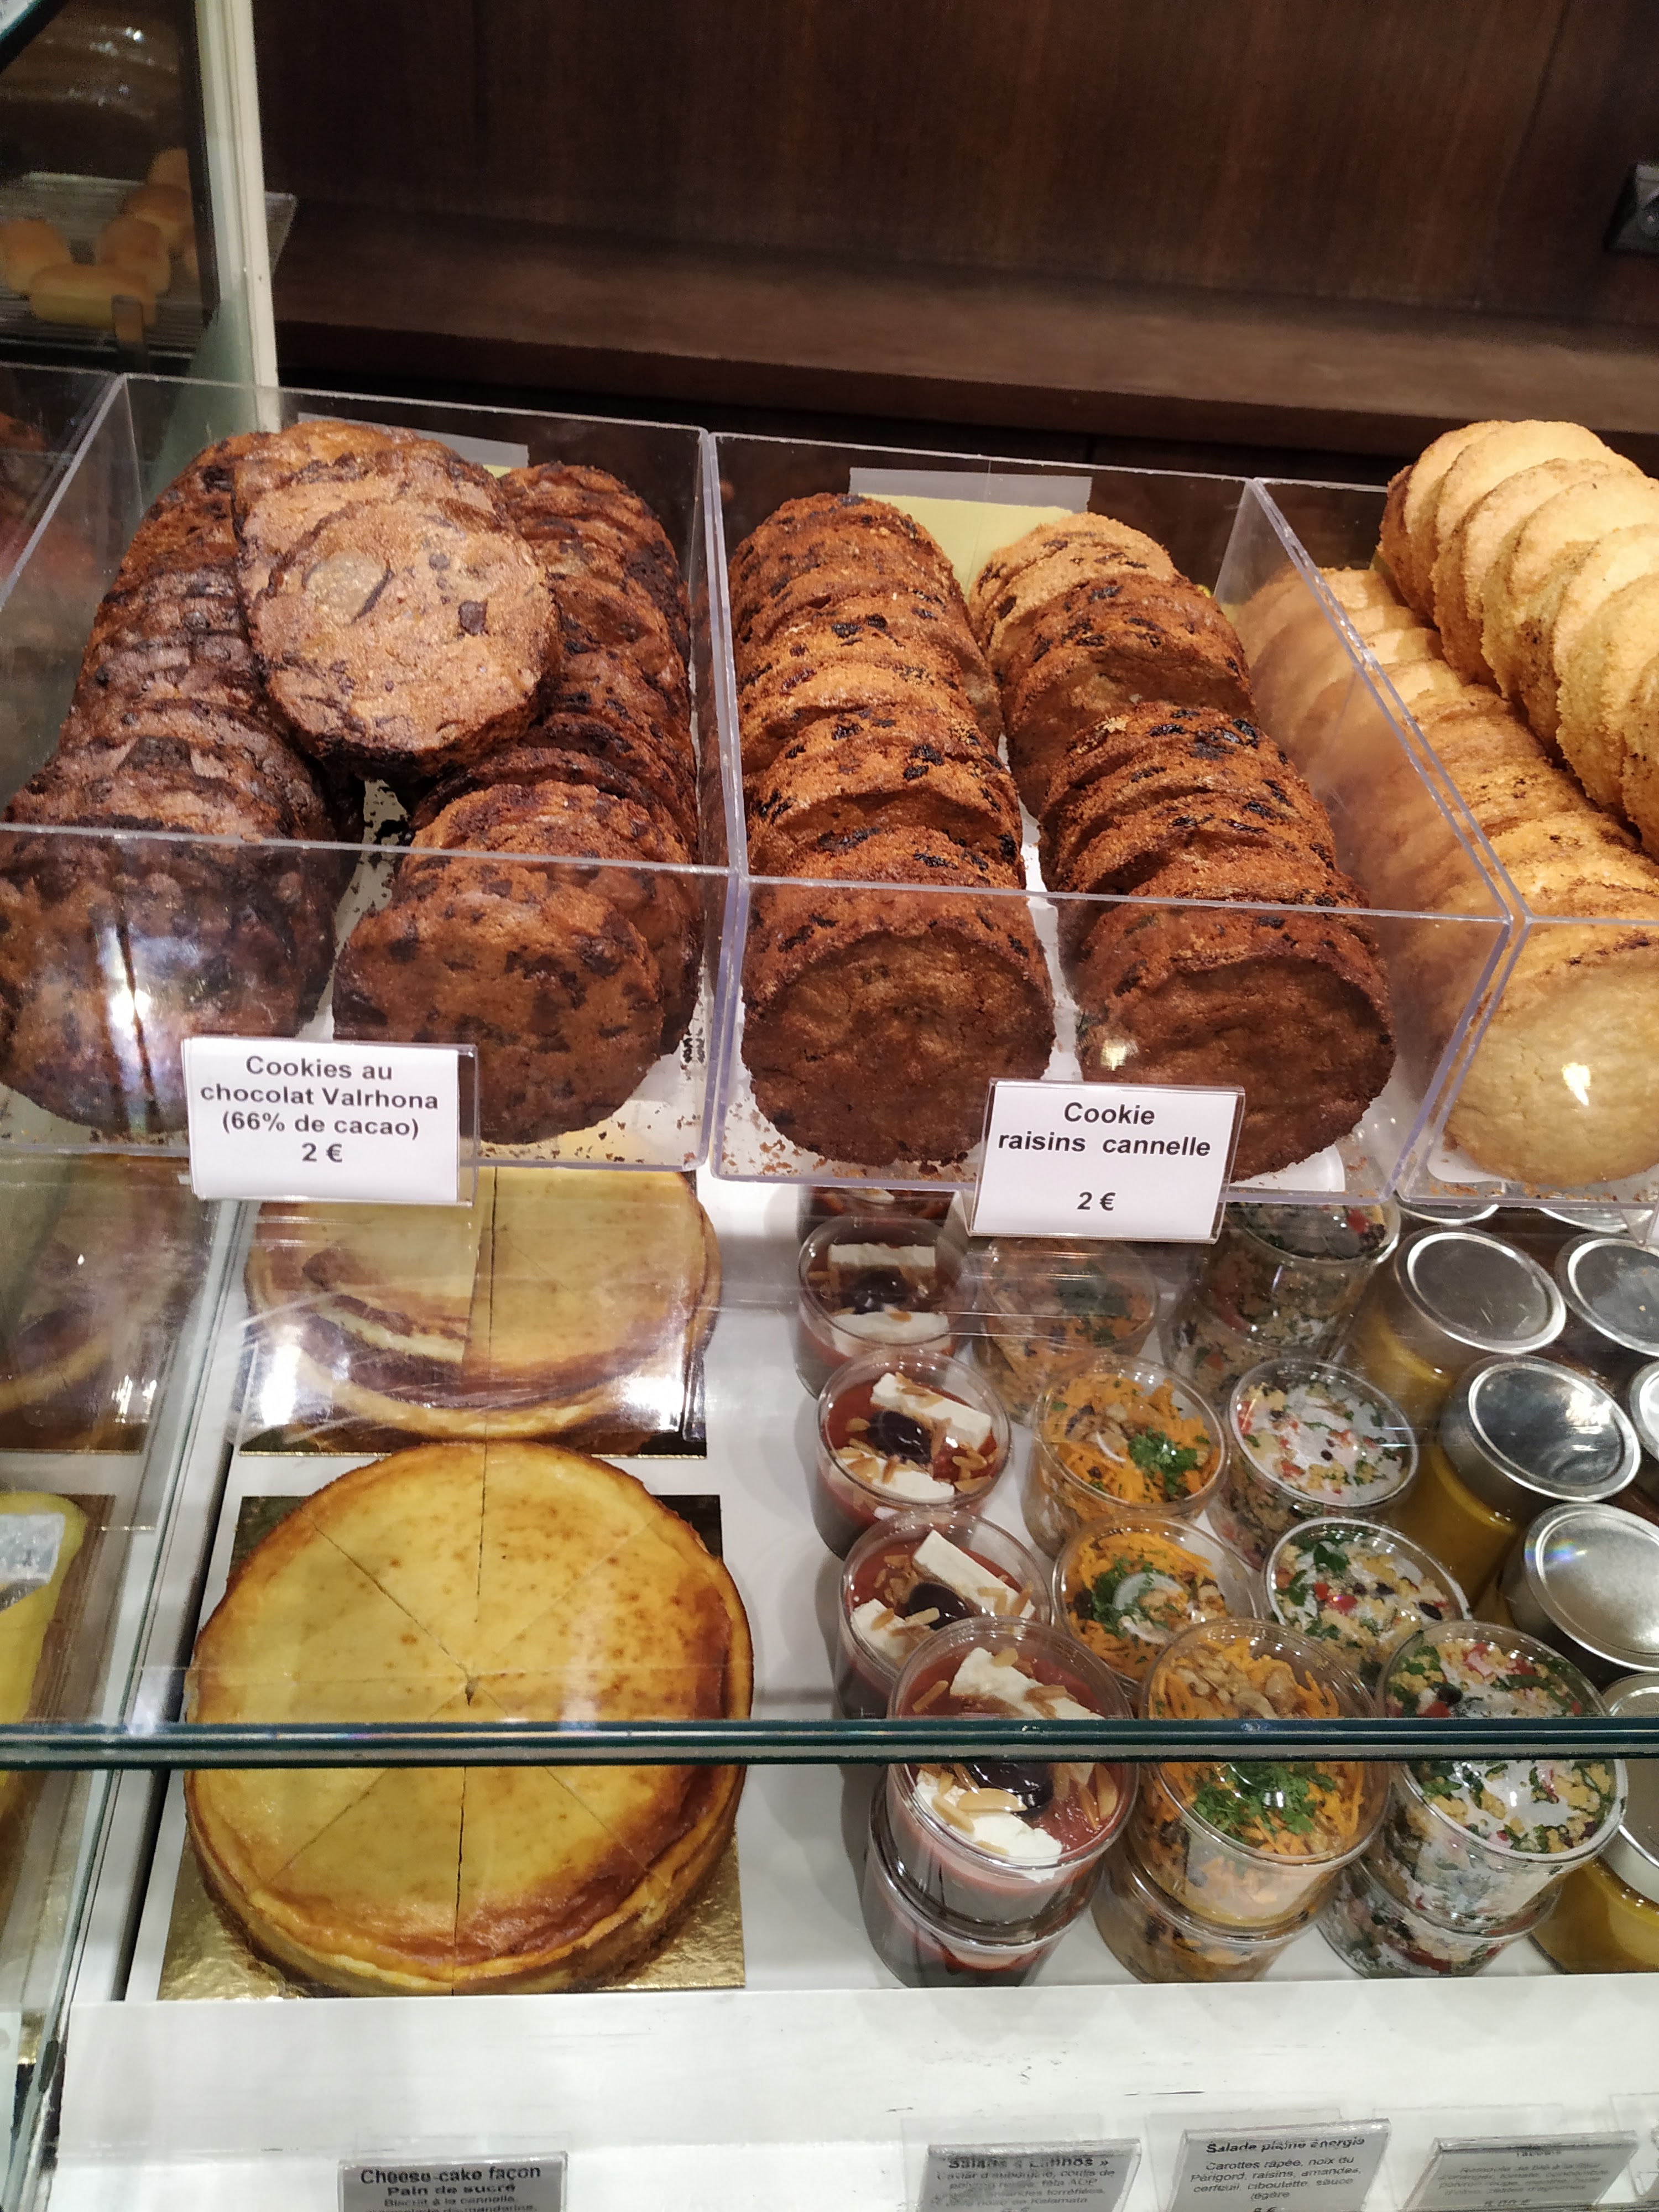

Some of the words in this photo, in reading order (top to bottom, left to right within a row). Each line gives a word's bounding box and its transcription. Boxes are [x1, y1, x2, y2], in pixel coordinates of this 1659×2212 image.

[246, 1056, 352, 1079] Cookies
[362, 1064, 392, 1080] au
[200, 1084, 315, 1105] chocolat
[322, 1088, 438, 1109] Valrhona
[1064, 1102, 1155, 1125] Cookie
[222, 1111, 285, 1134] (66%
[295, 1115, 325, 1133] de
[334, 1118, 419, 1139] cacao)
[998, 1131, 1086, 1152] raisins
[1102, 1136, 1211, 1156] cannelle
[302, 1143, 317, 1162] 2
[326, 1144, 343, 1163] €
[1077, 1192, 1092, 1211] 2
[1099, 1192, 1116, 1211] €
[1206, 2141, 1257, 2153] Salade
[1206, 2161, 1260, 2171] Carottes
[1308, 2157, 1335, 2166] noix
[1338, 2156, 1354, 2164] du
[489, 2166, 541, 2180] façon
[1099, 2169, 1115, 2177] de
[1190, 2171, 1247, 2183] Périgord,
[1252, 2169, 1296, 2179] raisins,
[1301, 2167, 1361, 2177] amandes,
[1316, 2177, 1354, 2186] sauce
[387, 2185, 429, 2196] Pain
[435, 2185, 458, 2194] de
